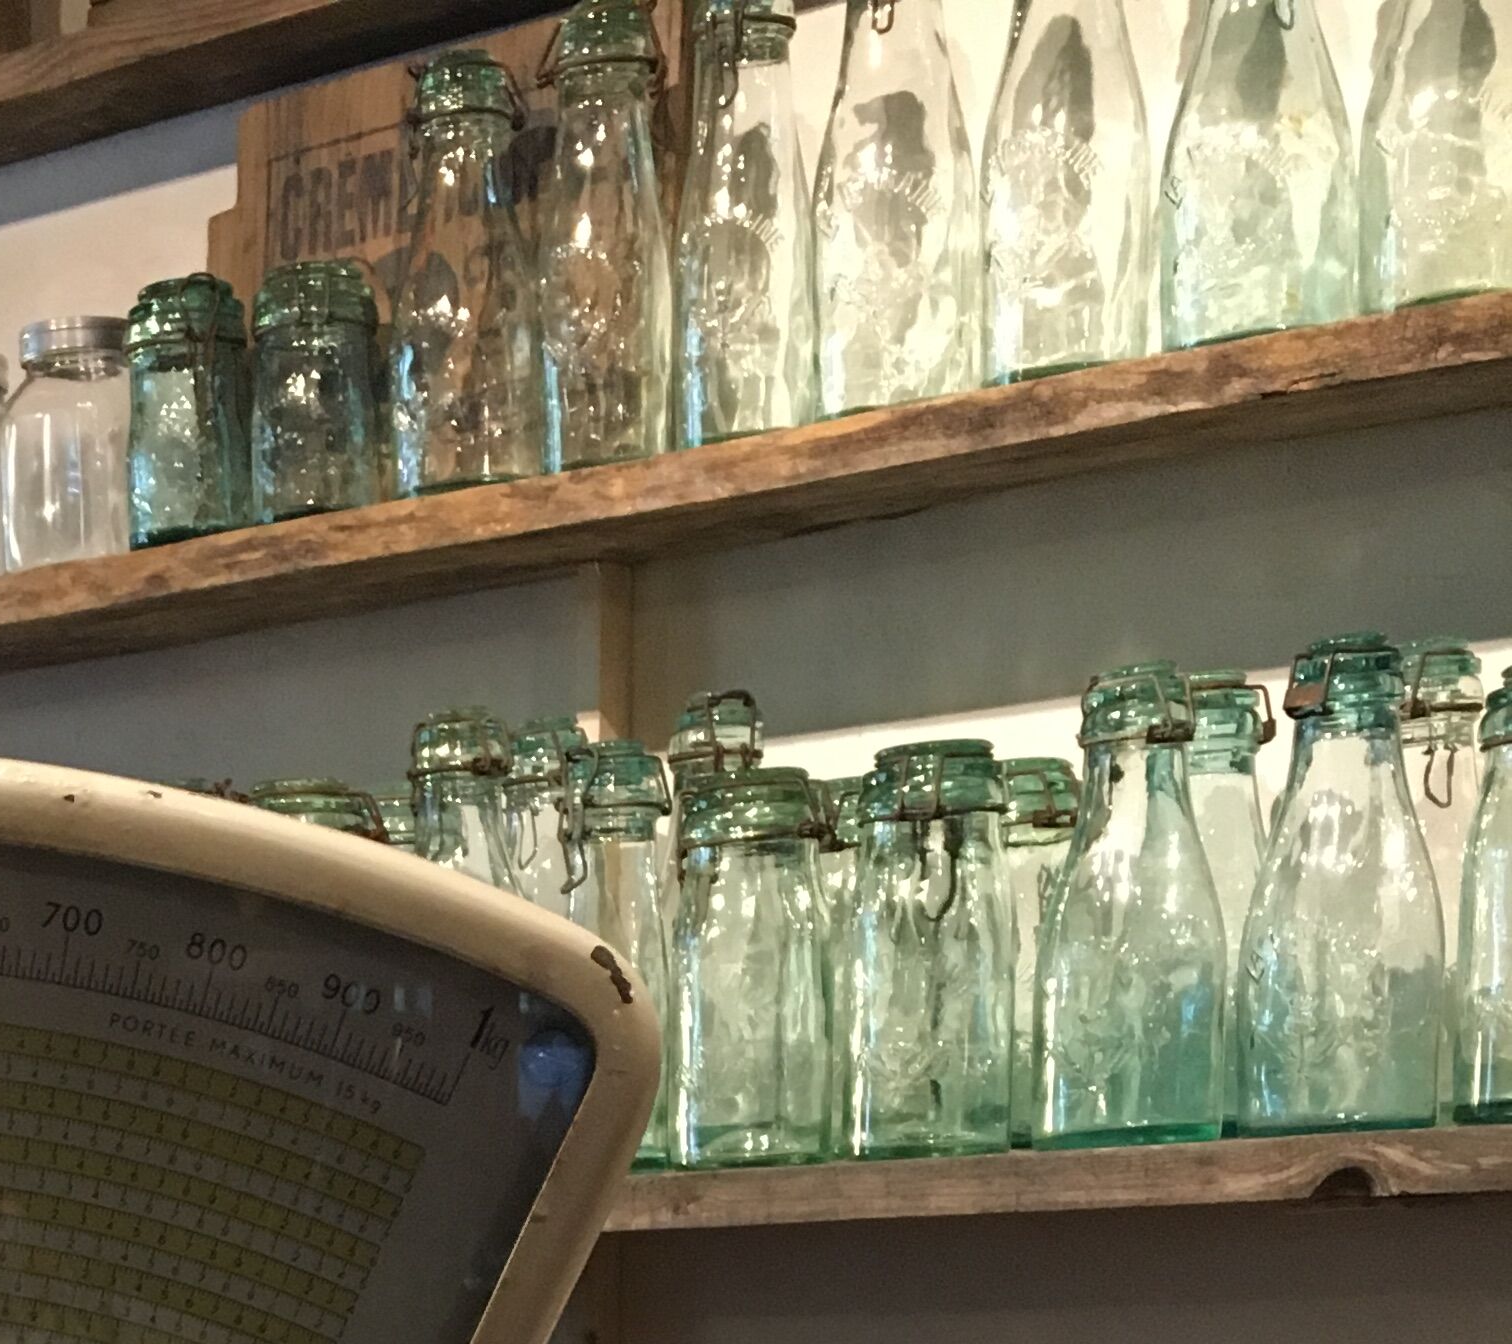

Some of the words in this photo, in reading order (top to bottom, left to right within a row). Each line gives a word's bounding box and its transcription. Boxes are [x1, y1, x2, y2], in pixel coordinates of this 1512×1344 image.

[40, 900, 105, 937] 700
[125, 939, 161, 962] 750
[186, 931, 249, 972] 800
[264, 974, 301, 999] 850
[320, 972, 382, 1016] 900
[390, 1022, 427, 1047] 950
[209, 1036, 326, 1088] MAXIMUM
[335, 1081, 355, 1100] 15
